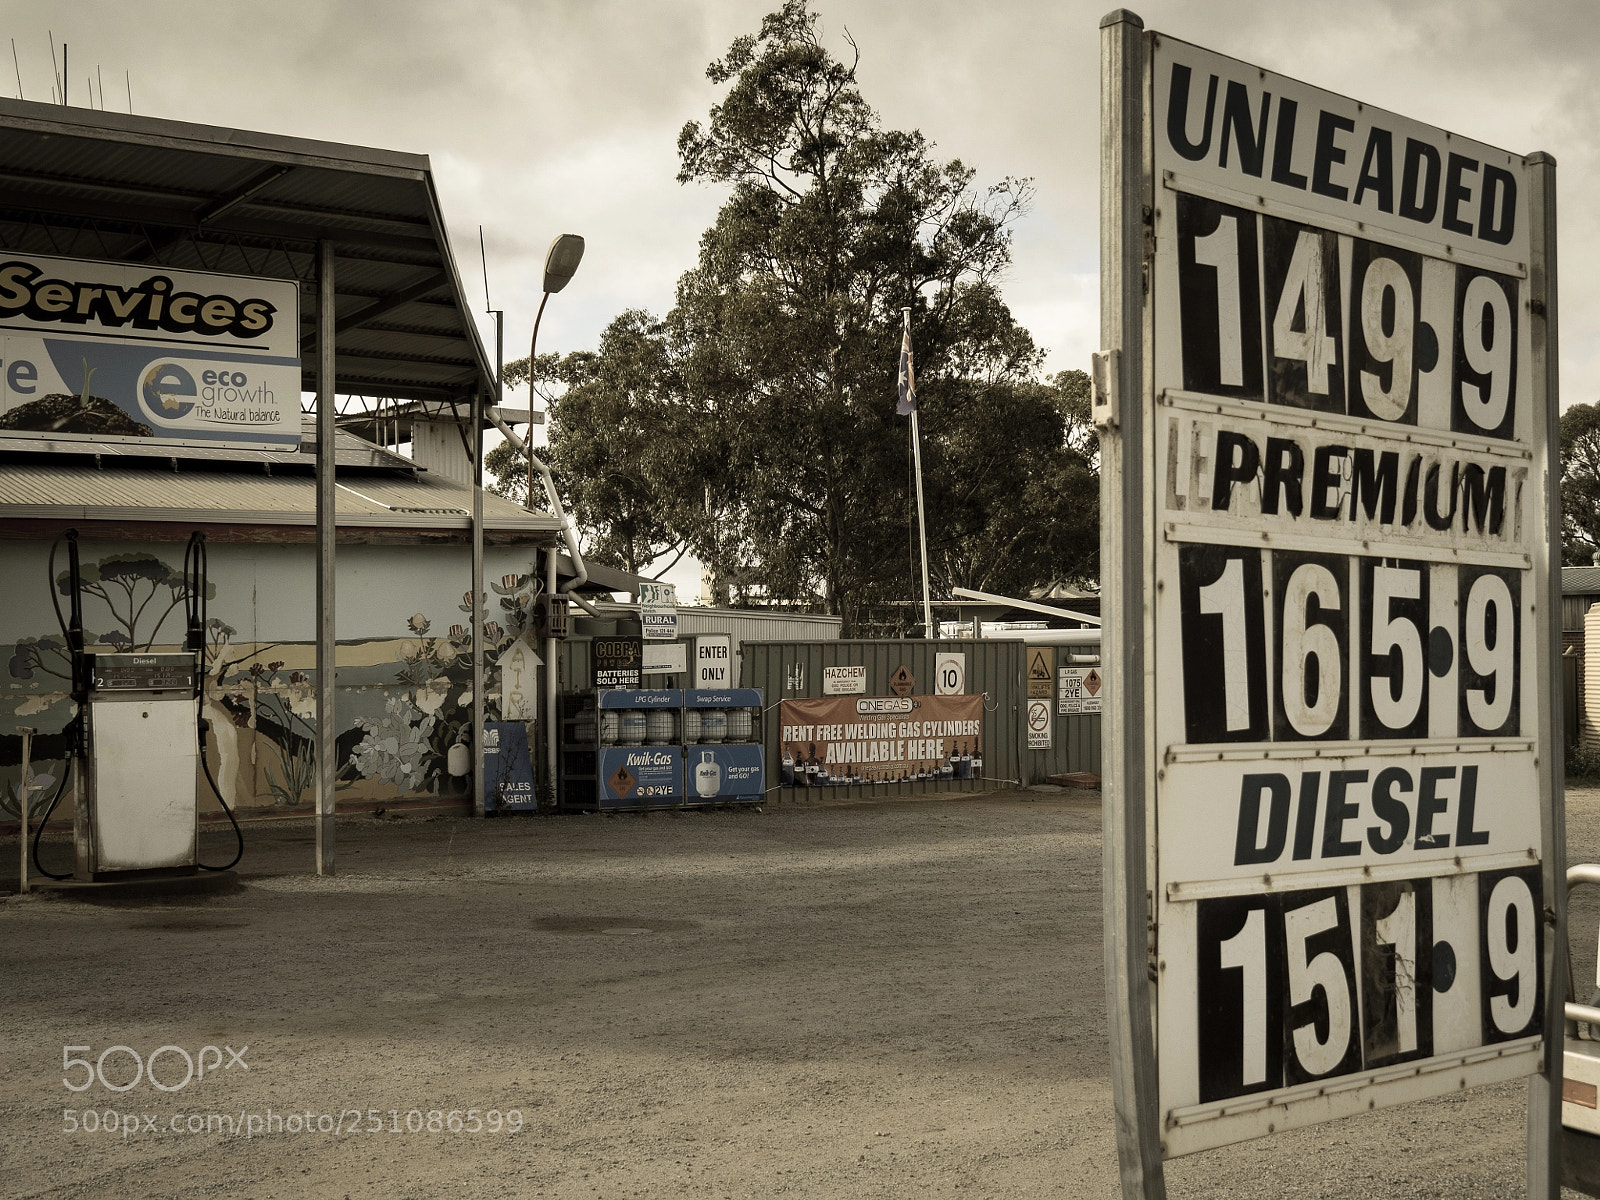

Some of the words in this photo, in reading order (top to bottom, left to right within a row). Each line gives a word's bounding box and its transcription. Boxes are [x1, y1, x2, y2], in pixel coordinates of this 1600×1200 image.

[1167, 63, 1517, 246] UNLEADED
[0, 261, 278, 339] Services
[202, 369, 248, 388] eco
[202, 381, 276, 408] growth
[195, 406, 211, 419] The
[214, 408, 247, 421] Natural
[249, 408, 281, 422] balance
[1212, 430, 1507, 536] PREMIUM
[645, 615, 674, 624] RURAL
[596, 641, 642, 658] COBRA
[699, 646, 728, 659] ENTER
[133, 657, 157, 665] Diesel
[597, 669, 640, 677] BATTERIES
[702, 667, 726, 681] ONLY
[825, 668, 865, 679] HAZCHEM
[942, 669, 958, 688] 10
[98, 678, 105, 687] 2
[596, 677, 618, 685] SOLD
[619, 676, 640, 684] HERE
[1066, 679, 1081, 688] 1075
[635, 695, 647, 703] LPG
[648, 694, 671, 705] Cylinder
[697, 694, 713, 705] Swap
[713, 694, 732, 703] Service
[1065, 689, 1080, 698] 2YE
[859, 700, 910, 711] ONEGAS
[783, 725, 814, 742] RENT
[816, 724, 842, 740] FREE
[844, 722, 896, 740] WELDING
[898, 721, 920, 738] GAS
[922, 719, 980, 737] CYLINDERS
[825, 740, 903, 764] AVAILABLE
[906, 739, 944, 762] HERE
[626, 751, 672, 767] Kwik-Gas
[750, 766, 760, 774] gas
[655, 785, 673, 796] 2YE
[1234, 765, 1489, 866] DIESEL
